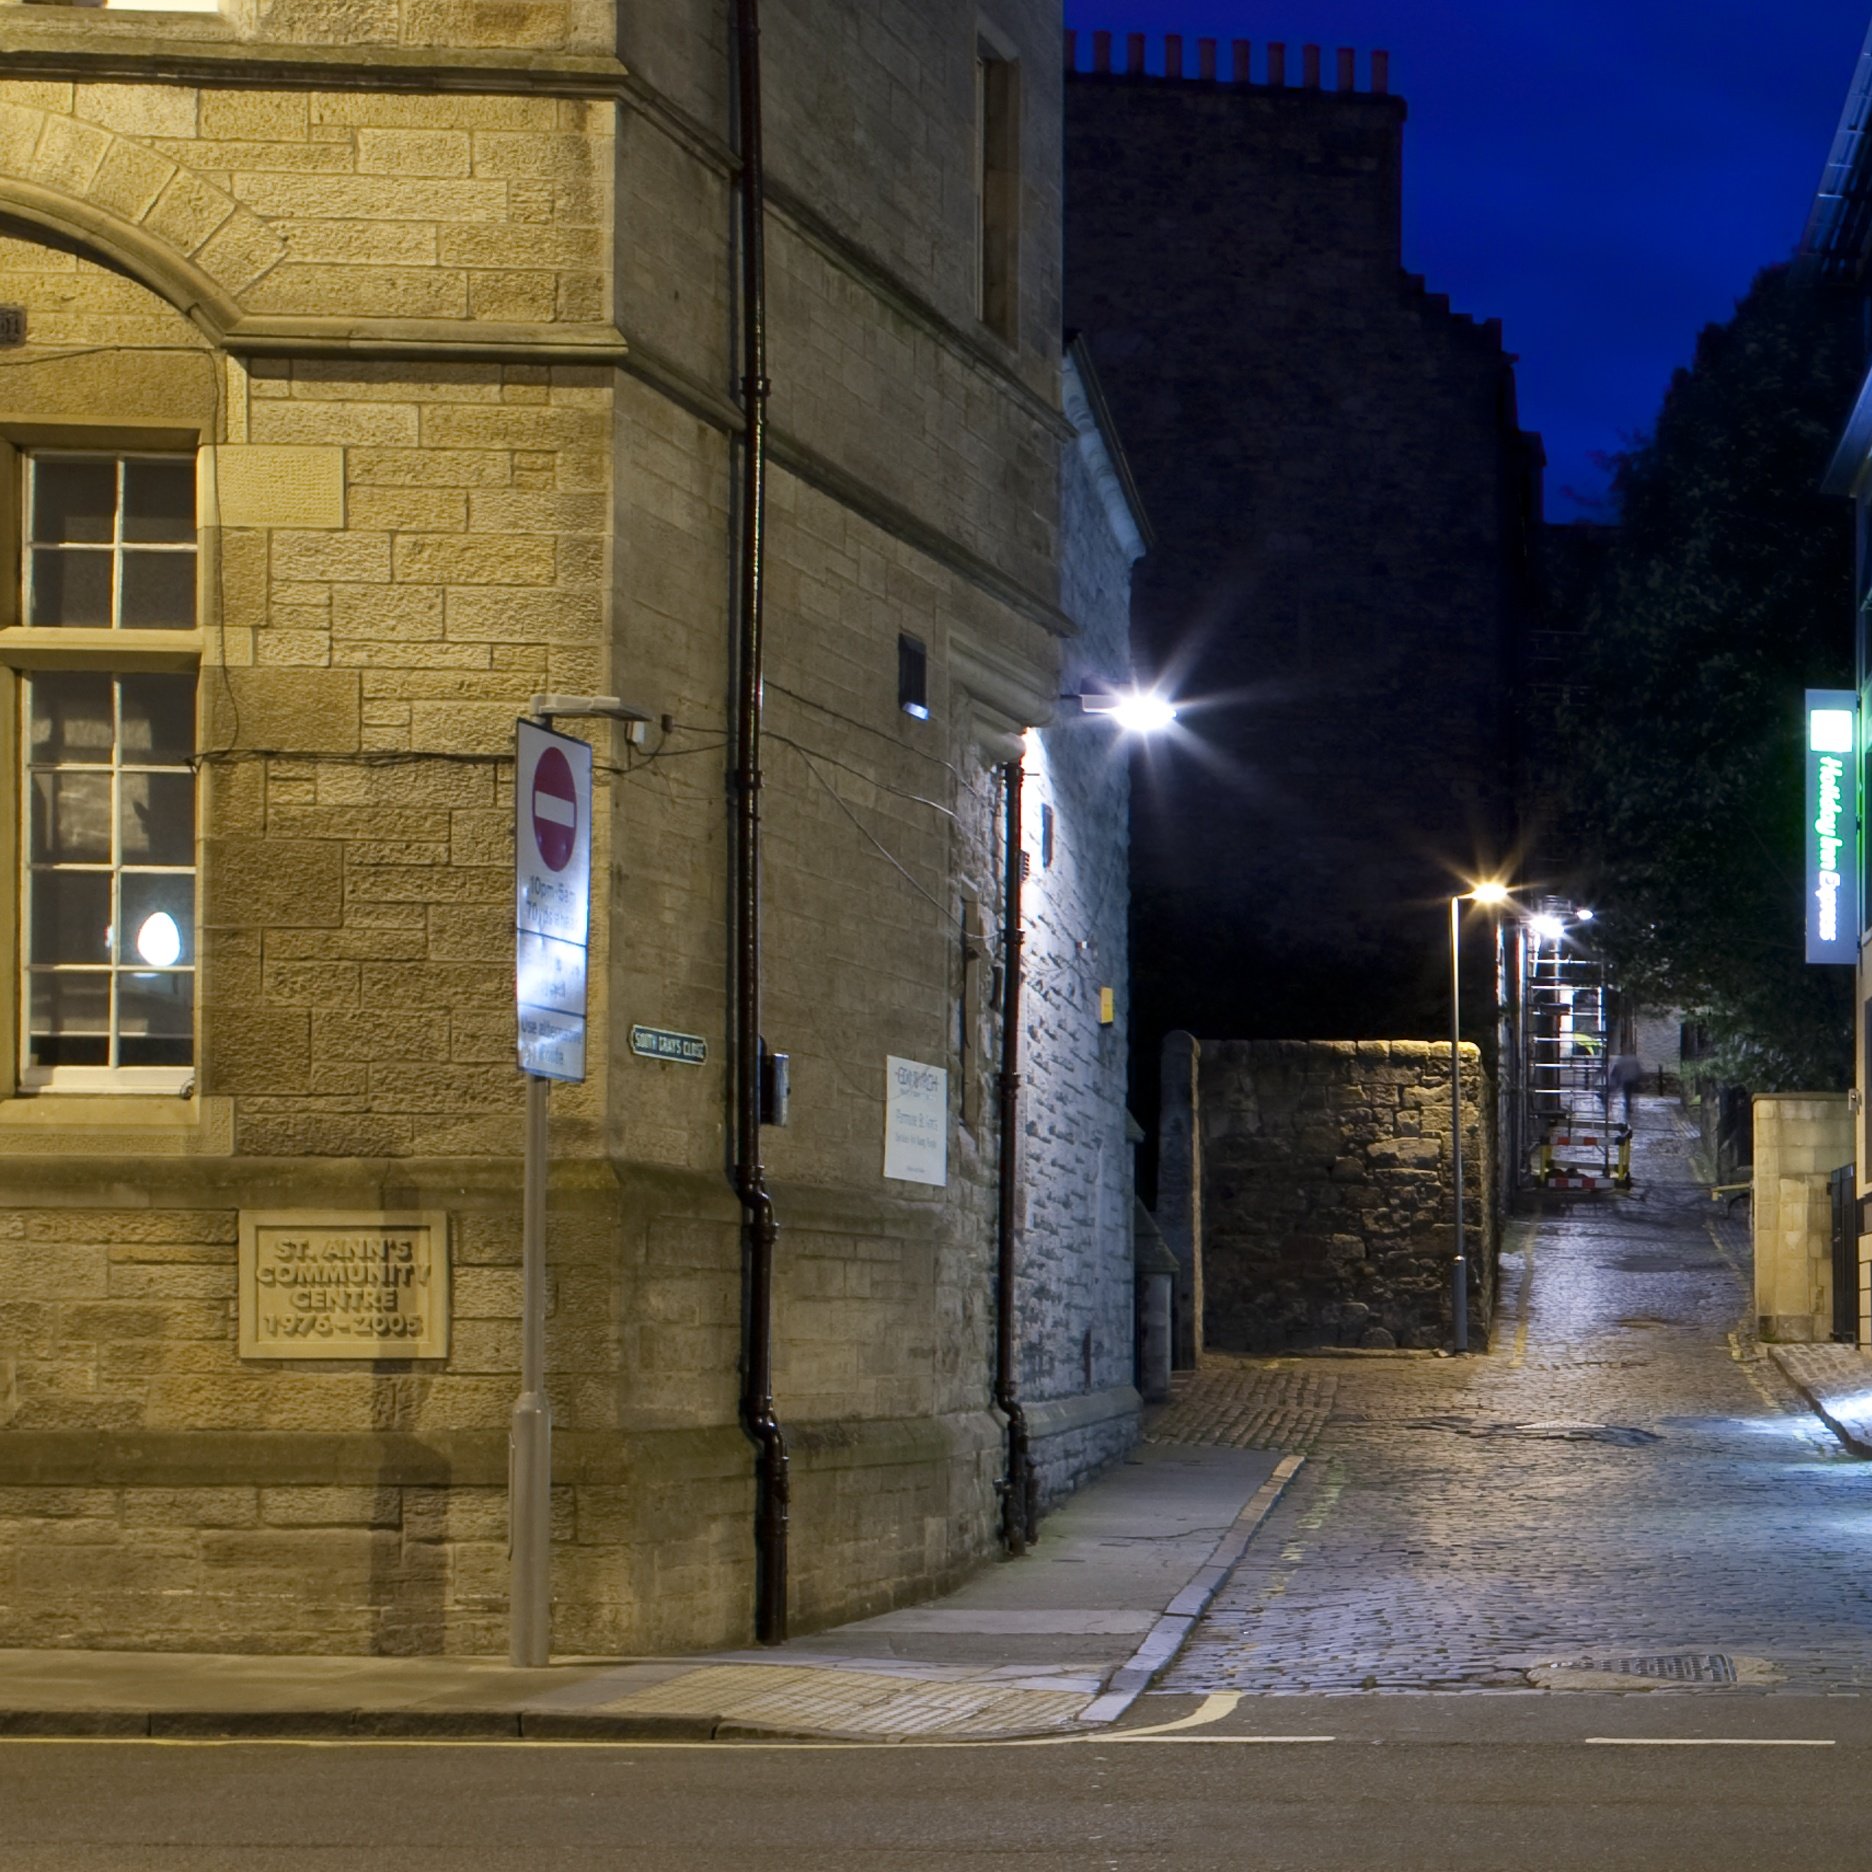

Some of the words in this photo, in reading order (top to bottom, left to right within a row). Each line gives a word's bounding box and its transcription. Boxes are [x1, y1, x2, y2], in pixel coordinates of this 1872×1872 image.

[274, 1238, 318, 1264] ST.
[321, 1237, 414, 1264] ANN'S
[256, 1263, 432, 1288] COMMUNITY
[291, 1288, 398, 1313] CENTRE
